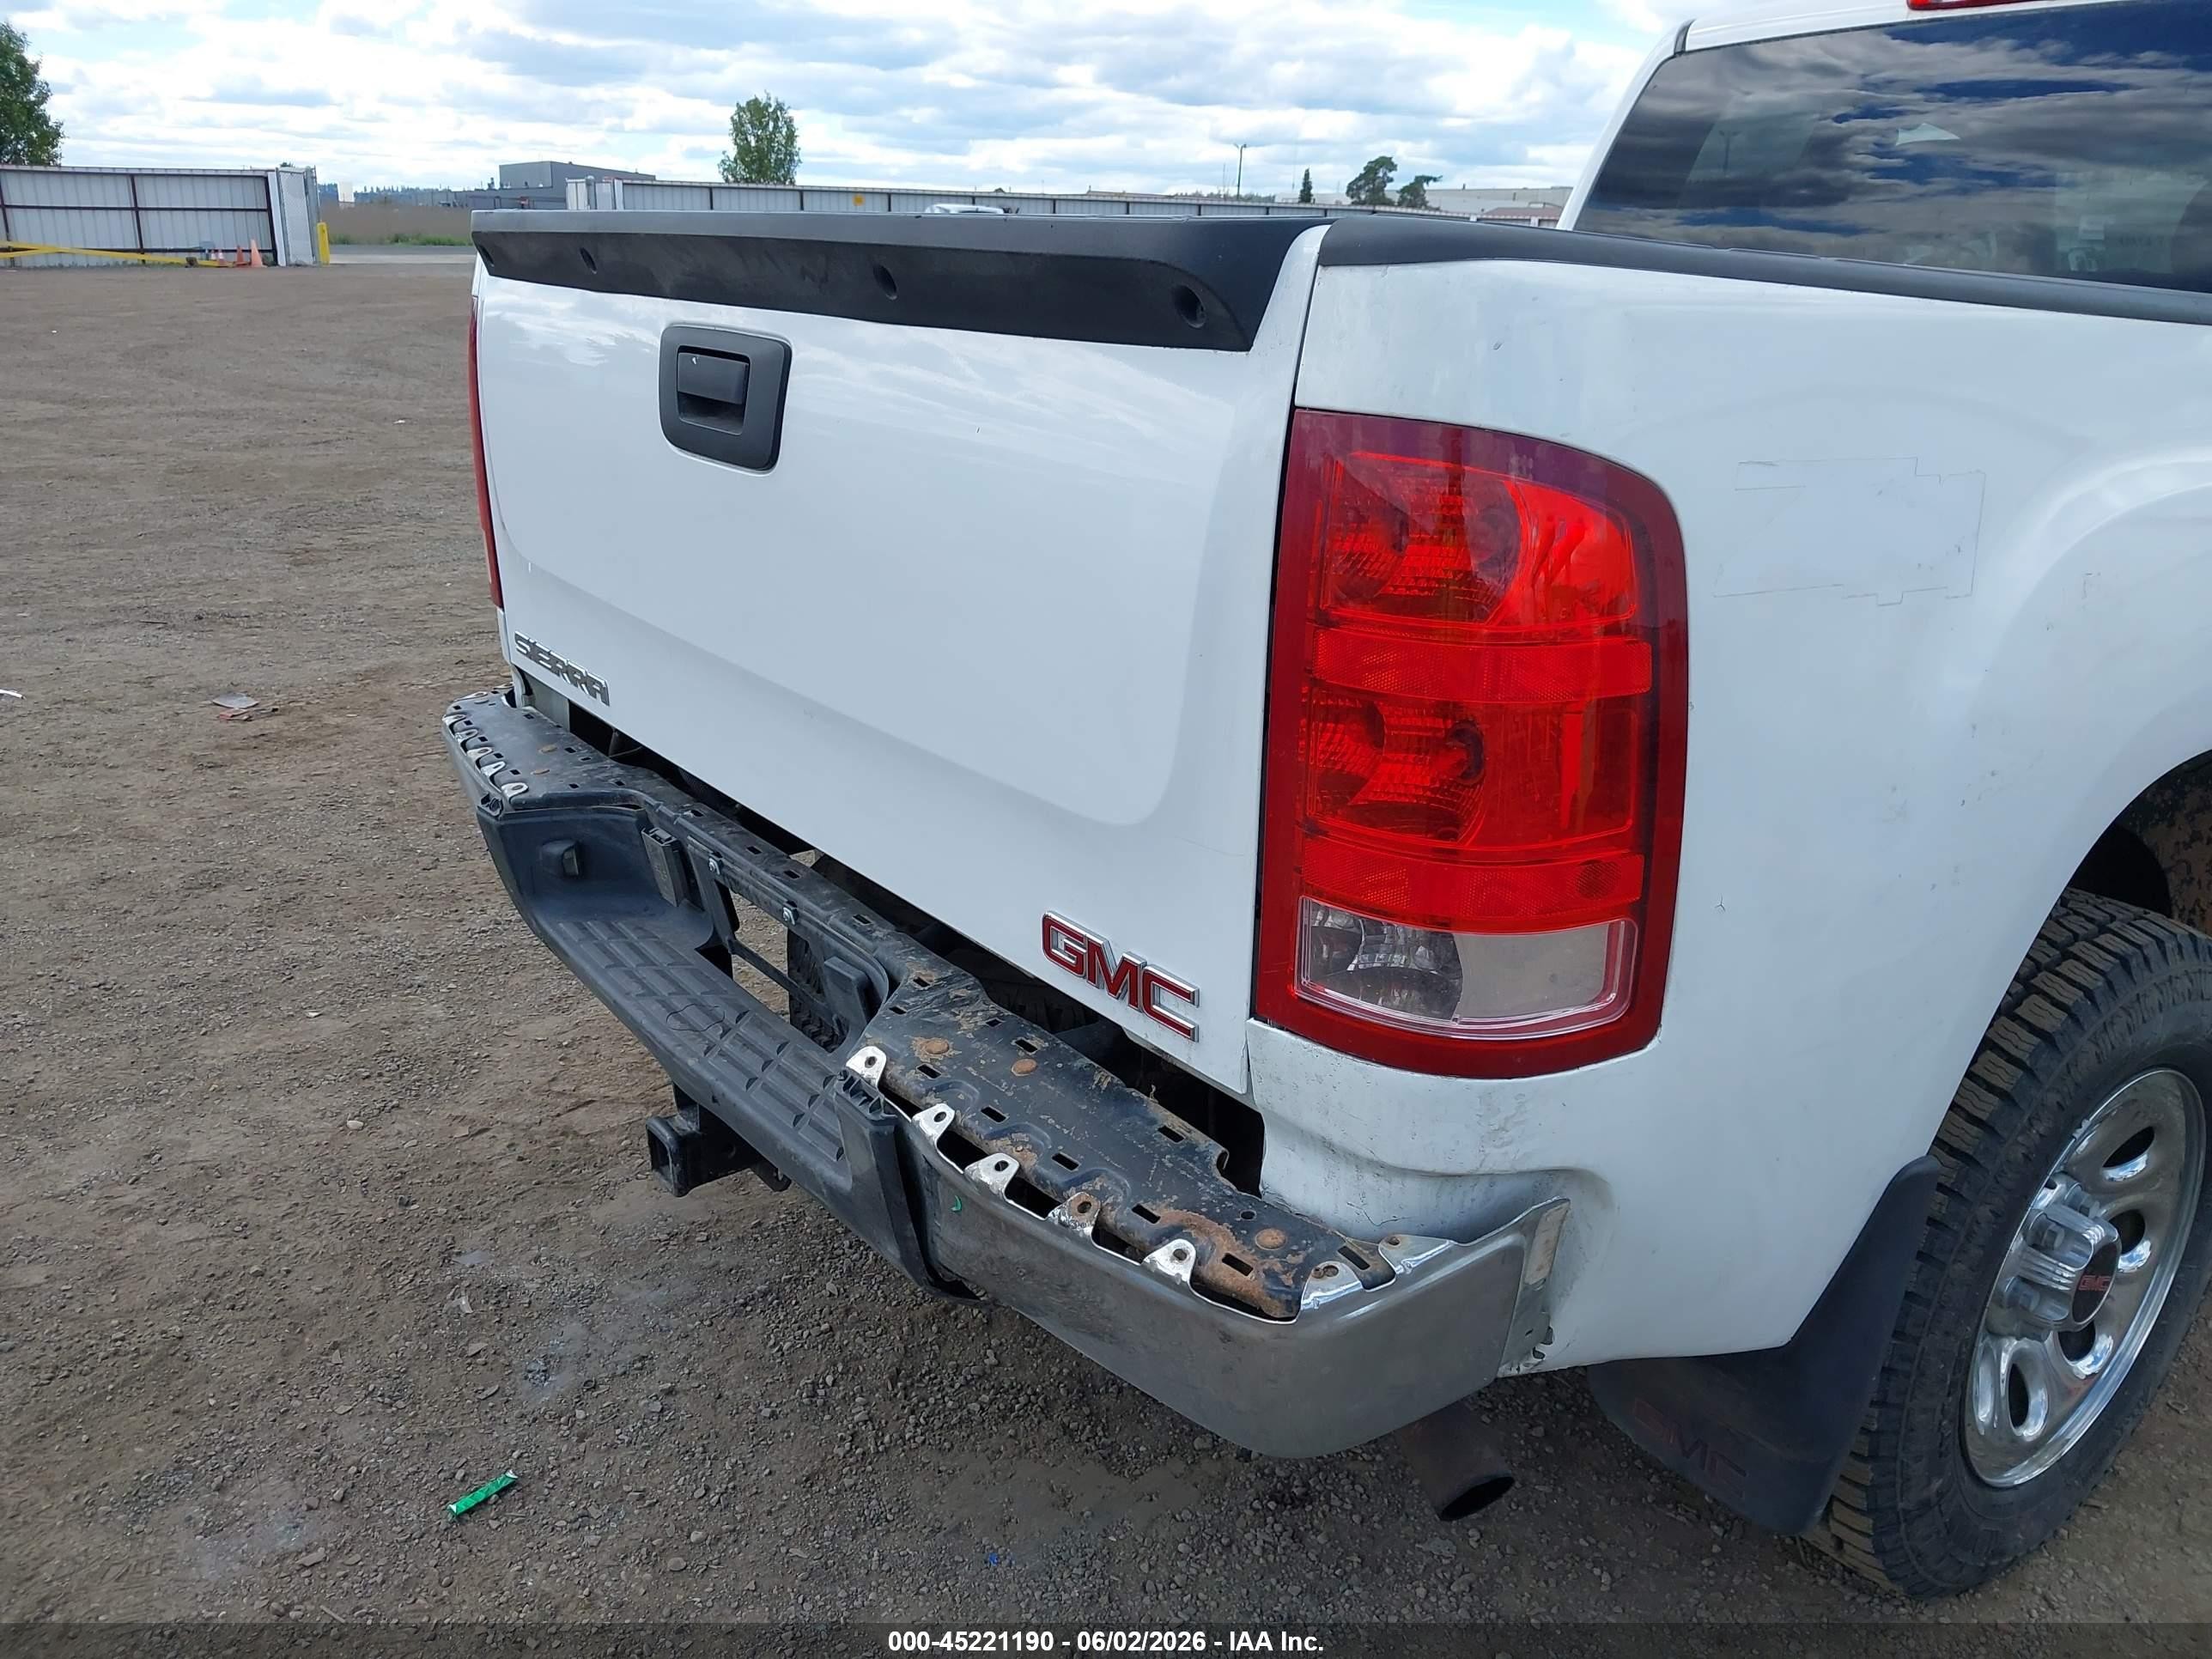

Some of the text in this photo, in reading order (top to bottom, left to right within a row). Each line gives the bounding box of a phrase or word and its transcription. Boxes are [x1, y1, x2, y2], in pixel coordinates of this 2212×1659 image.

[514, 630, 611, 706] SIERRA
[1042, 911, 1200, 1042] GMC
[2077, 1274, 2112, 1291] GMC
